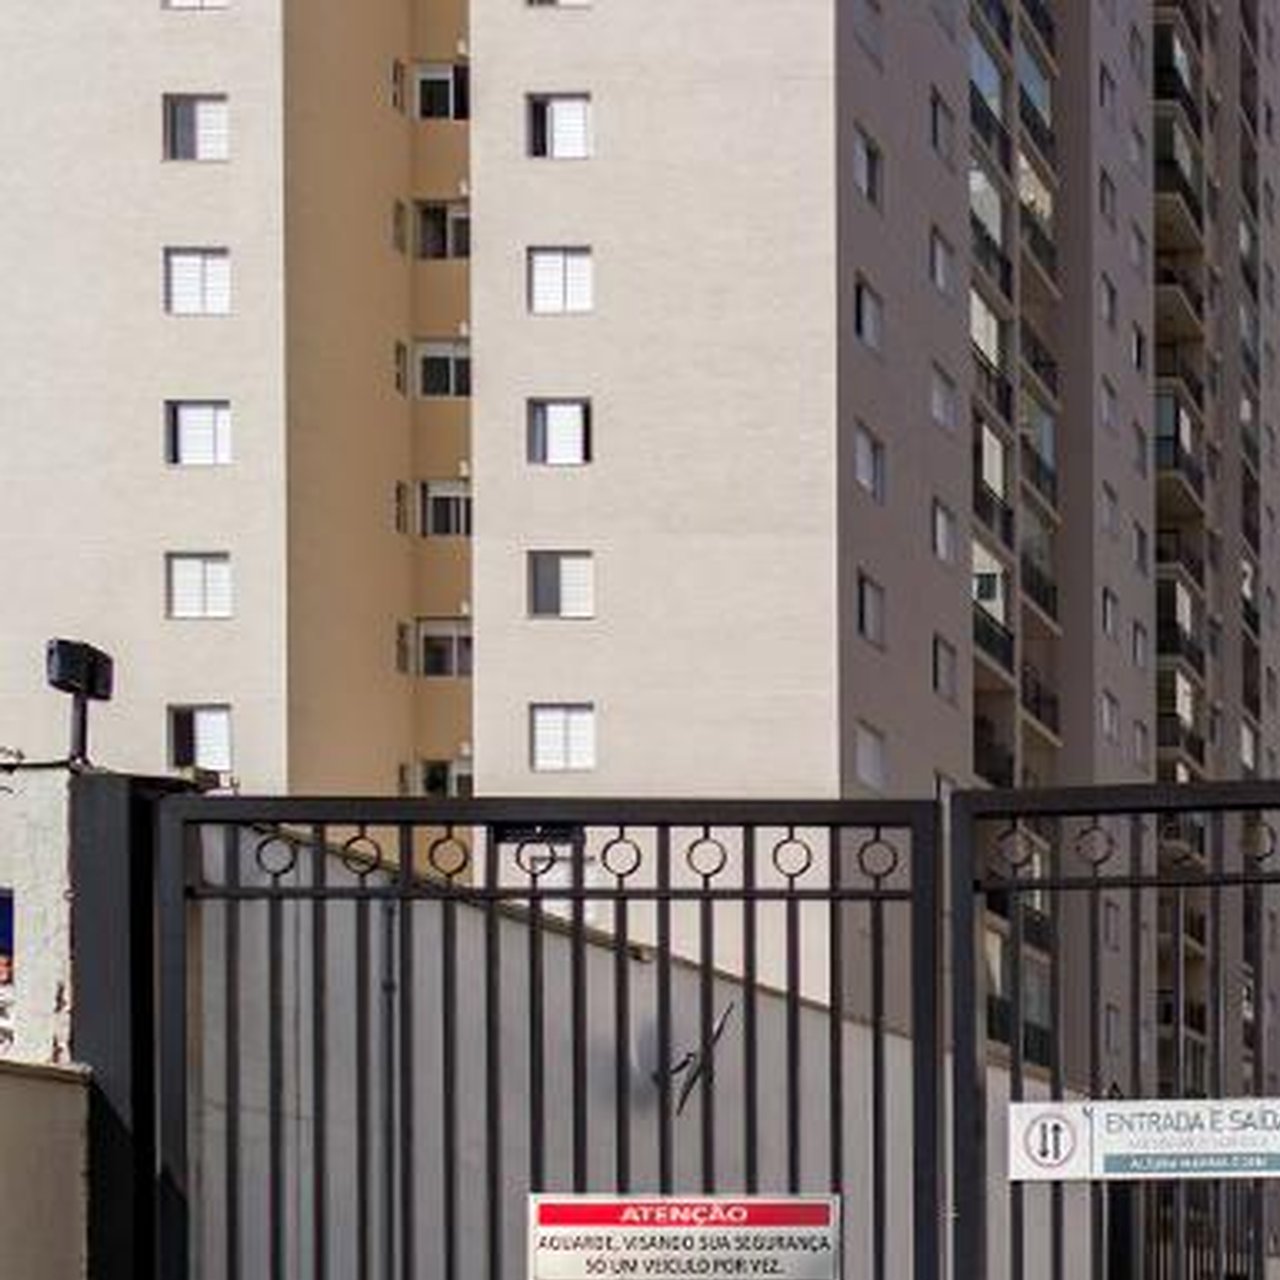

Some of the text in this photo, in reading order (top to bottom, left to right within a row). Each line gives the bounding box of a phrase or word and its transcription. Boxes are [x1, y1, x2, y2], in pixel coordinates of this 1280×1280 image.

[1105, 1111, 1202, 1133] ENTRADA
[1211, 1109, 1223, 1131] E
[619, 1202, 749, 1226] ATENÇÃO
[622, 1235, 695, 1251] VISANDO
[699, 1235, 731, 1251] SUA
[734, 1235, 832, 1254] SEGURANÇA
[585, 1254, 607, 1274] SÓ
[713, 1258, 748, 1274] POR
